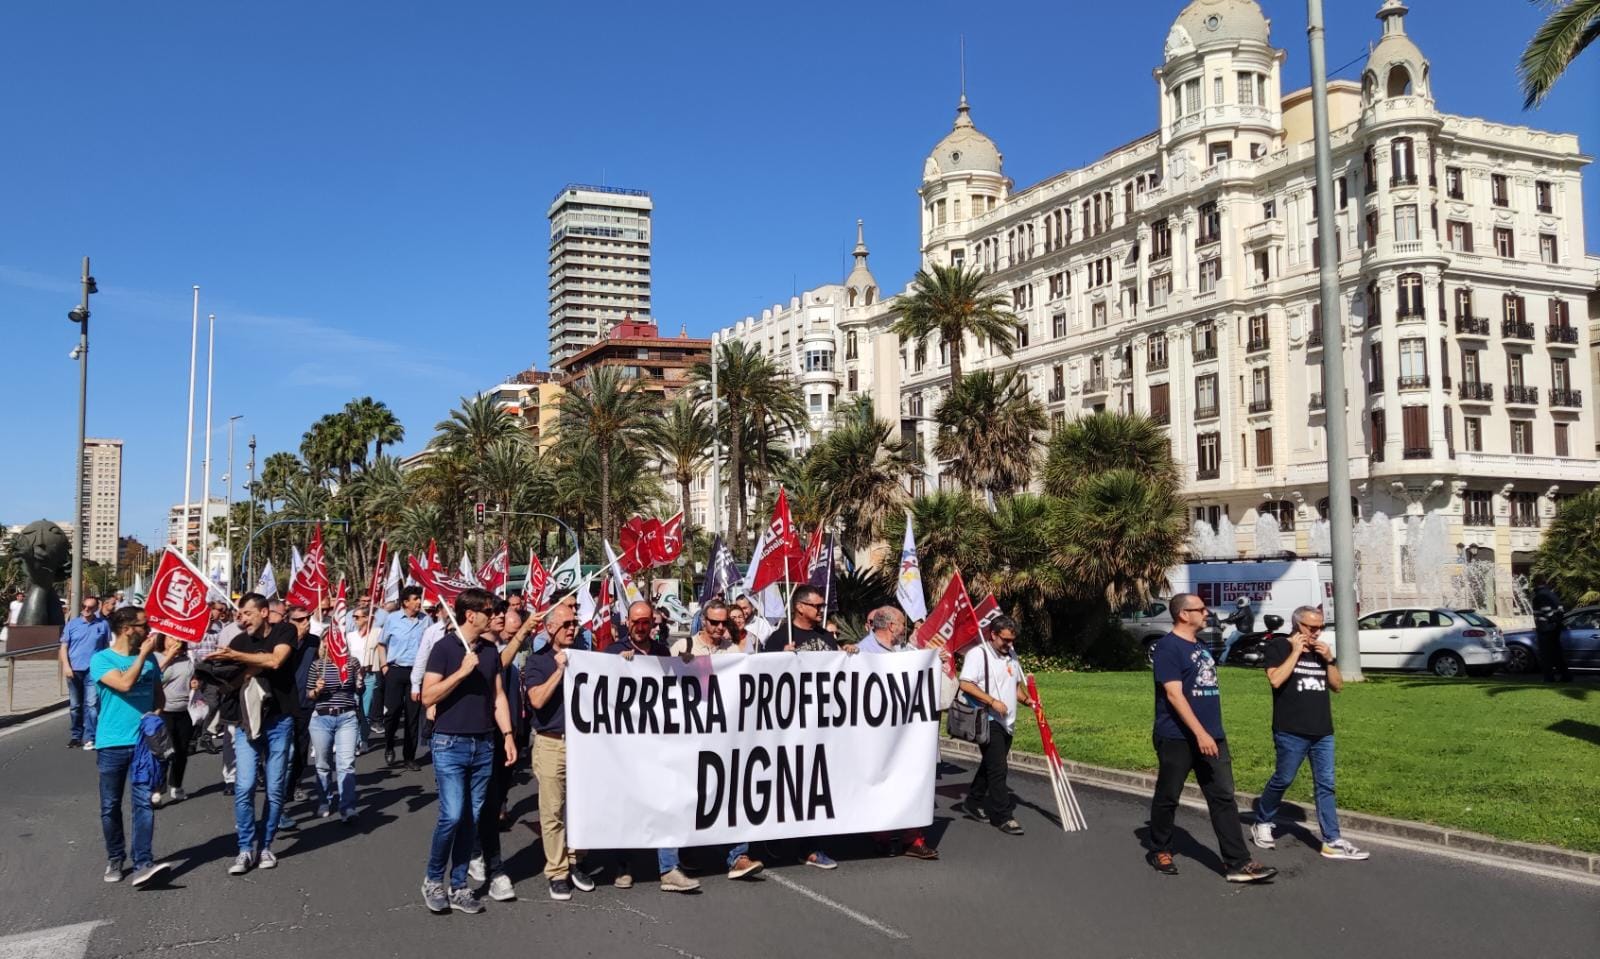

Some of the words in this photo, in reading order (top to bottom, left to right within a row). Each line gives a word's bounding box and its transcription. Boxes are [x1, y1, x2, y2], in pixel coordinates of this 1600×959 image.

[163, 570, 192, 612] UGT
[1223, 582, 1273, 592] ELECTRO
[571, 672, 727, 735] CARRERA
[738, 667, 942, 732] PROFESIONAL
[695, 743, 835, 830] DIGNA
